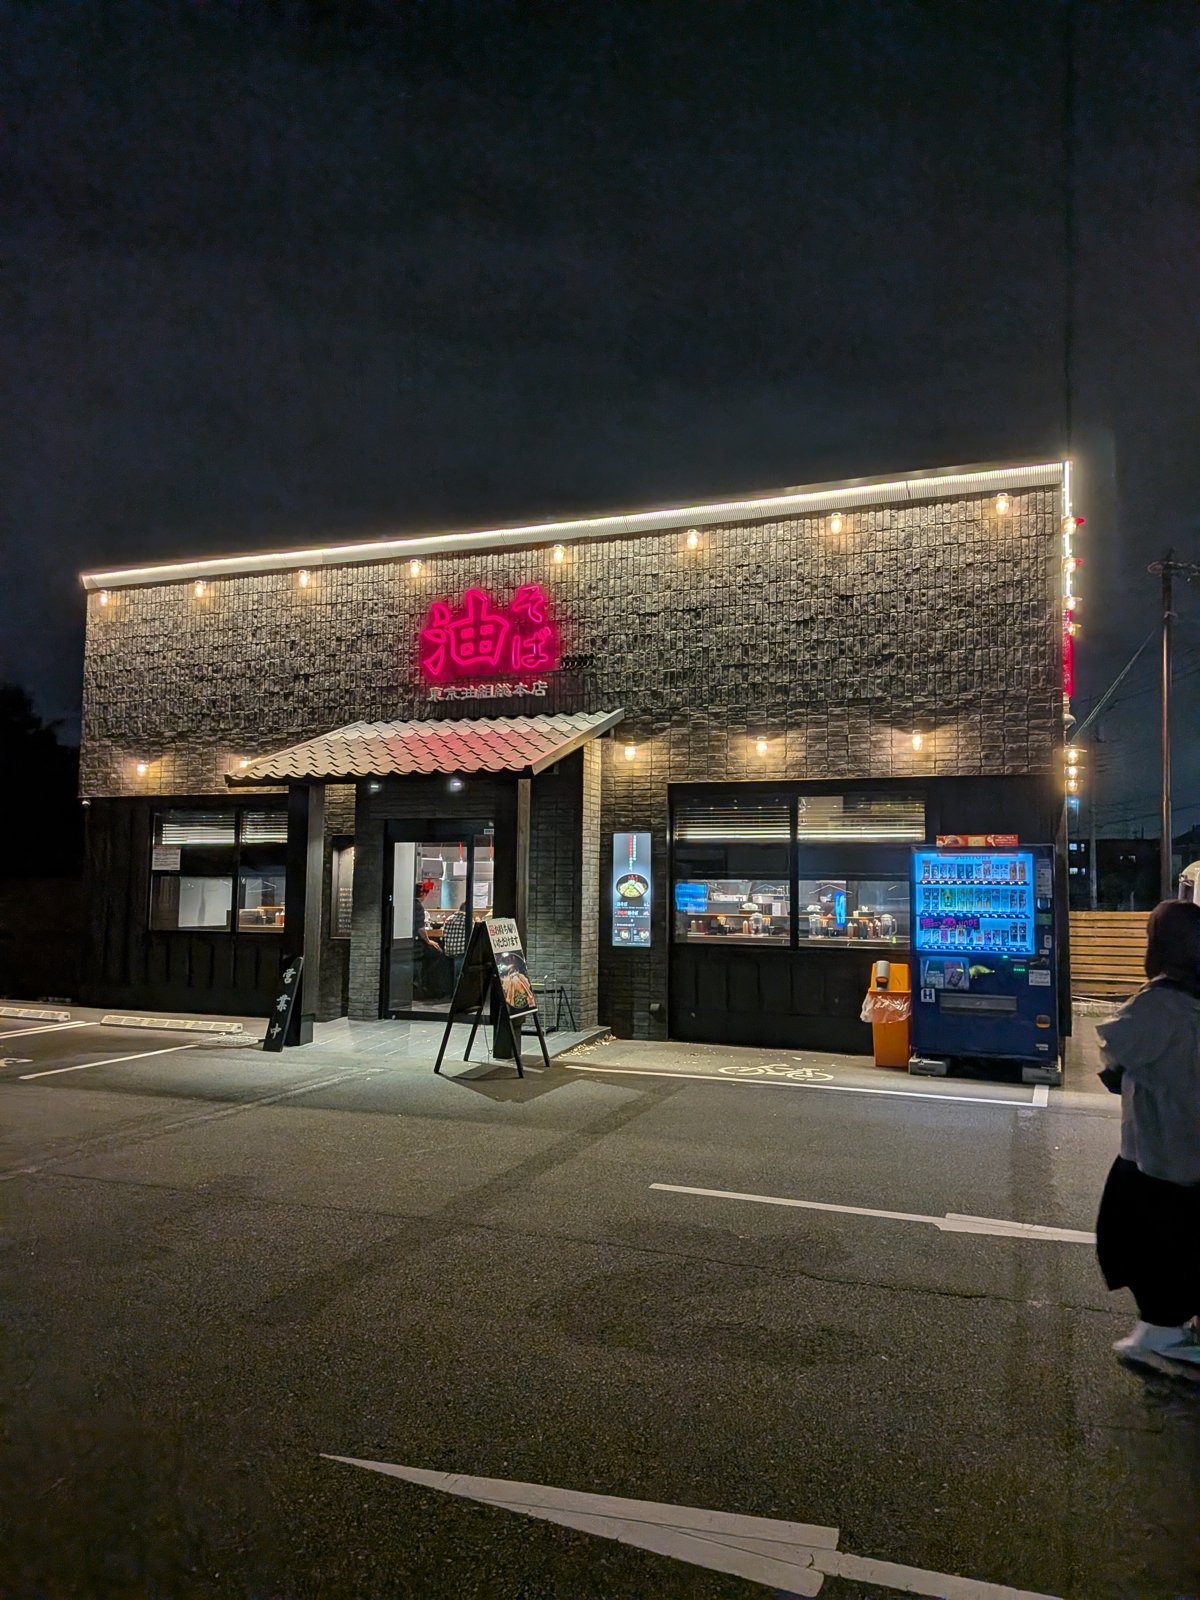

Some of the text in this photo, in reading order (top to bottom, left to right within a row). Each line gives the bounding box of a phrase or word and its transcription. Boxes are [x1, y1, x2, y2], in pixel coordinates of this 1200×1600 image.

[423, 585, 551, 675] 油そば
[427, 680, 548, 702] 東京油組総本店
[493, 936, 518, 947] いただけます
[270, 968, 296, 1039] 営業中
